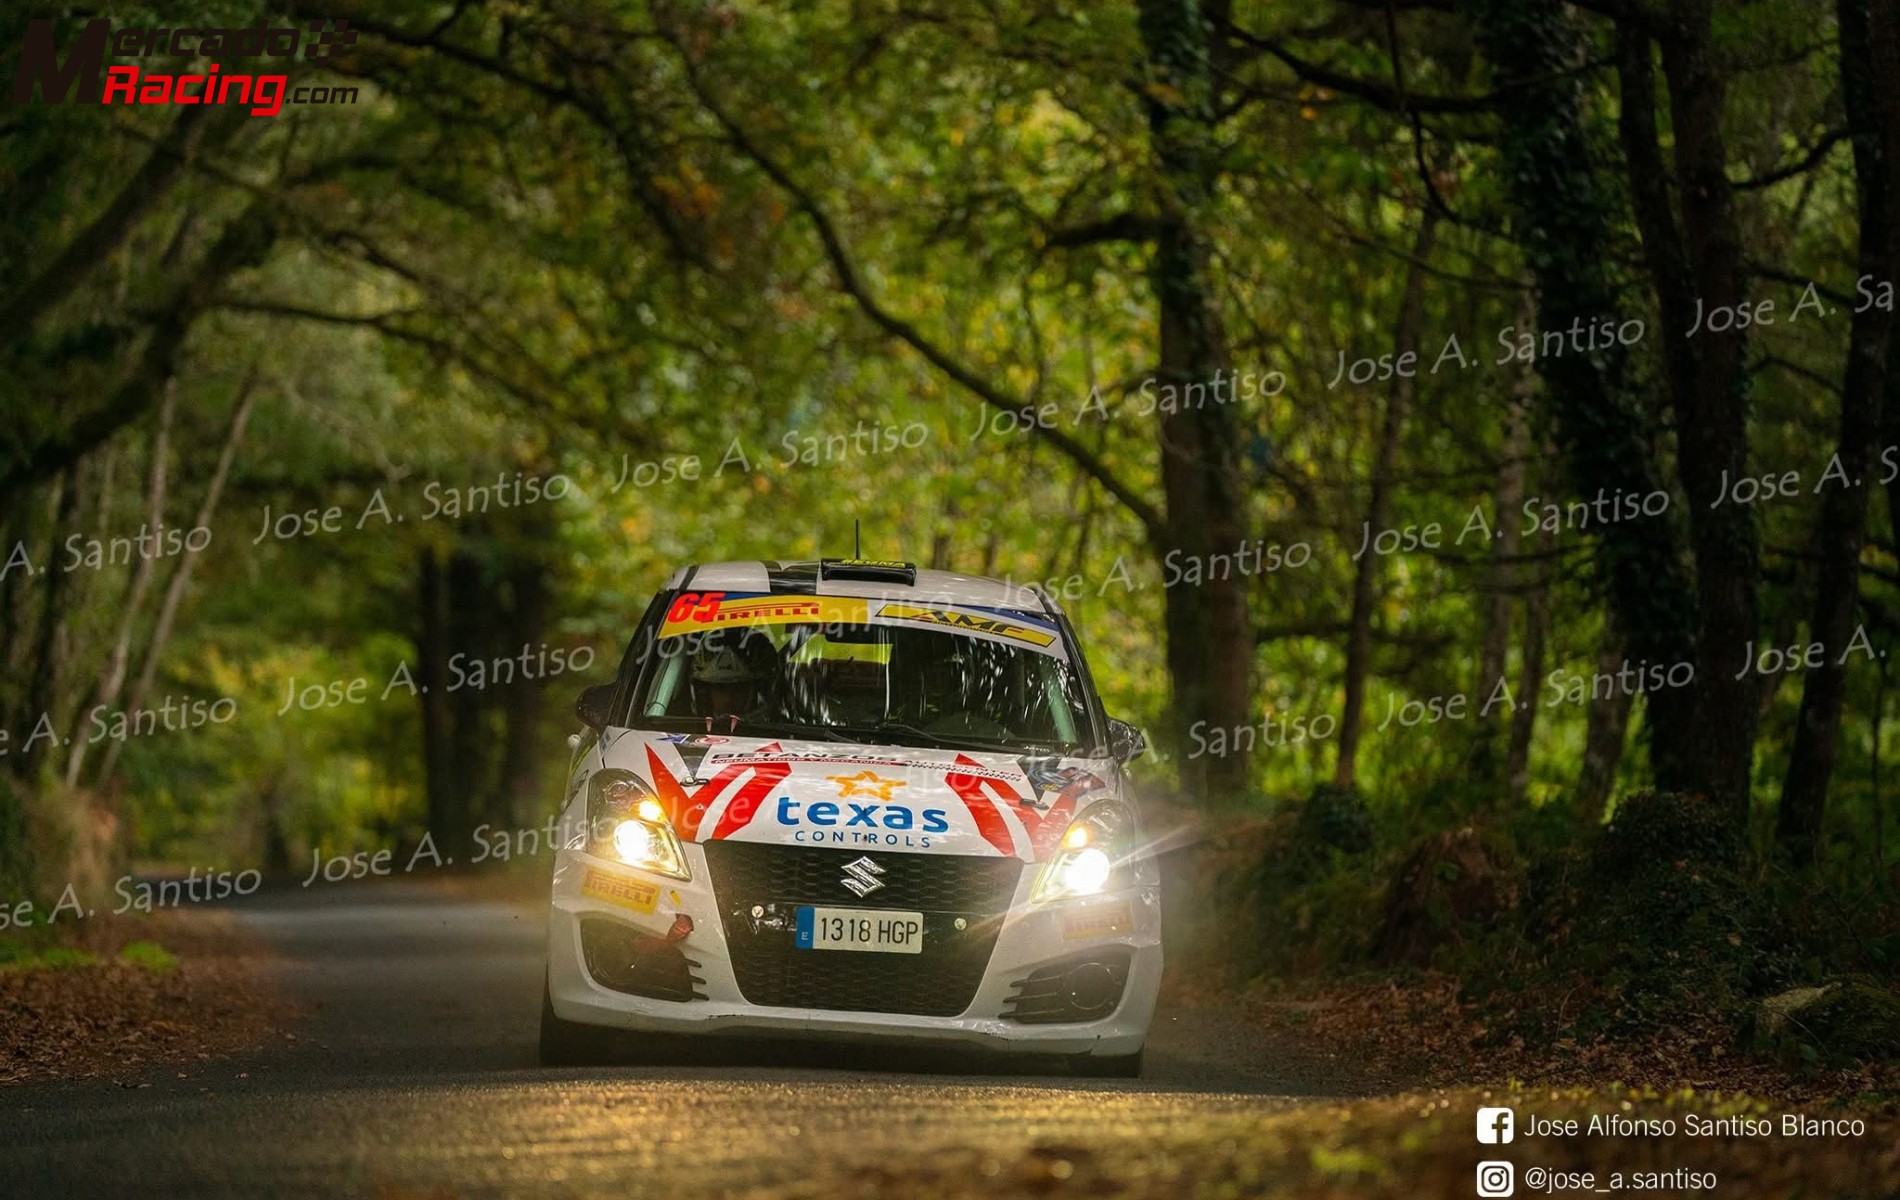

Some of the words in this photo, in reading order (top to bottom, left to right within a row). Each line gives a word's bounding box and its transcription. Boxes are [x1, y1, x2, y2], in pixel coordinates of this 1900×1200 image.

[668, 593, 725, 624] 65
[776, 797, 949, 833] texas
[795, 830, 931, 848] CONTROLS
[821, 917, 871, 942] 1318
[878, 919, 919, 945] HGP
